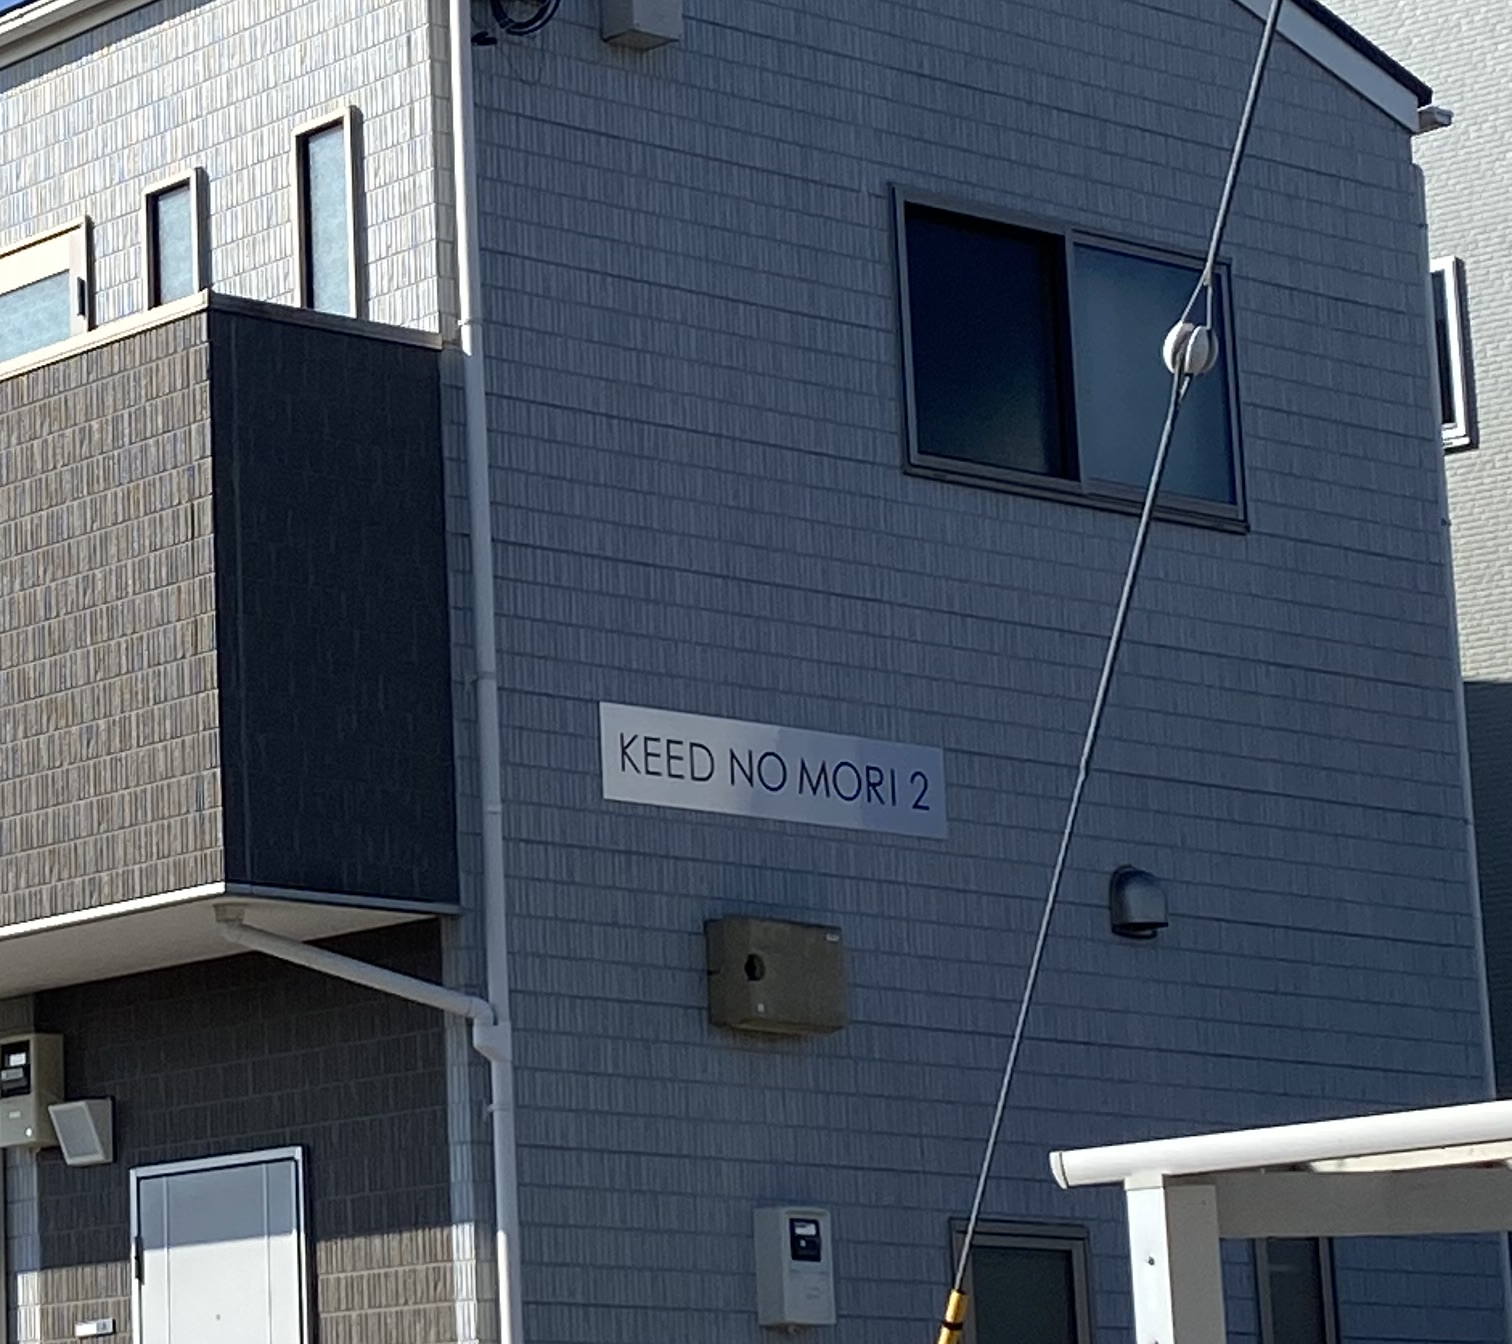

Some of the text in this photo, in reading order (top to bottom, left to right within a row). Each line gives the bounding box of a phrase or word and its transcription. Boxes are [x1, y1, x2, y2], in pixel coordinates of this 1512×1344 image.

[619, 732, 931, 811] KEED NO MORI 2
